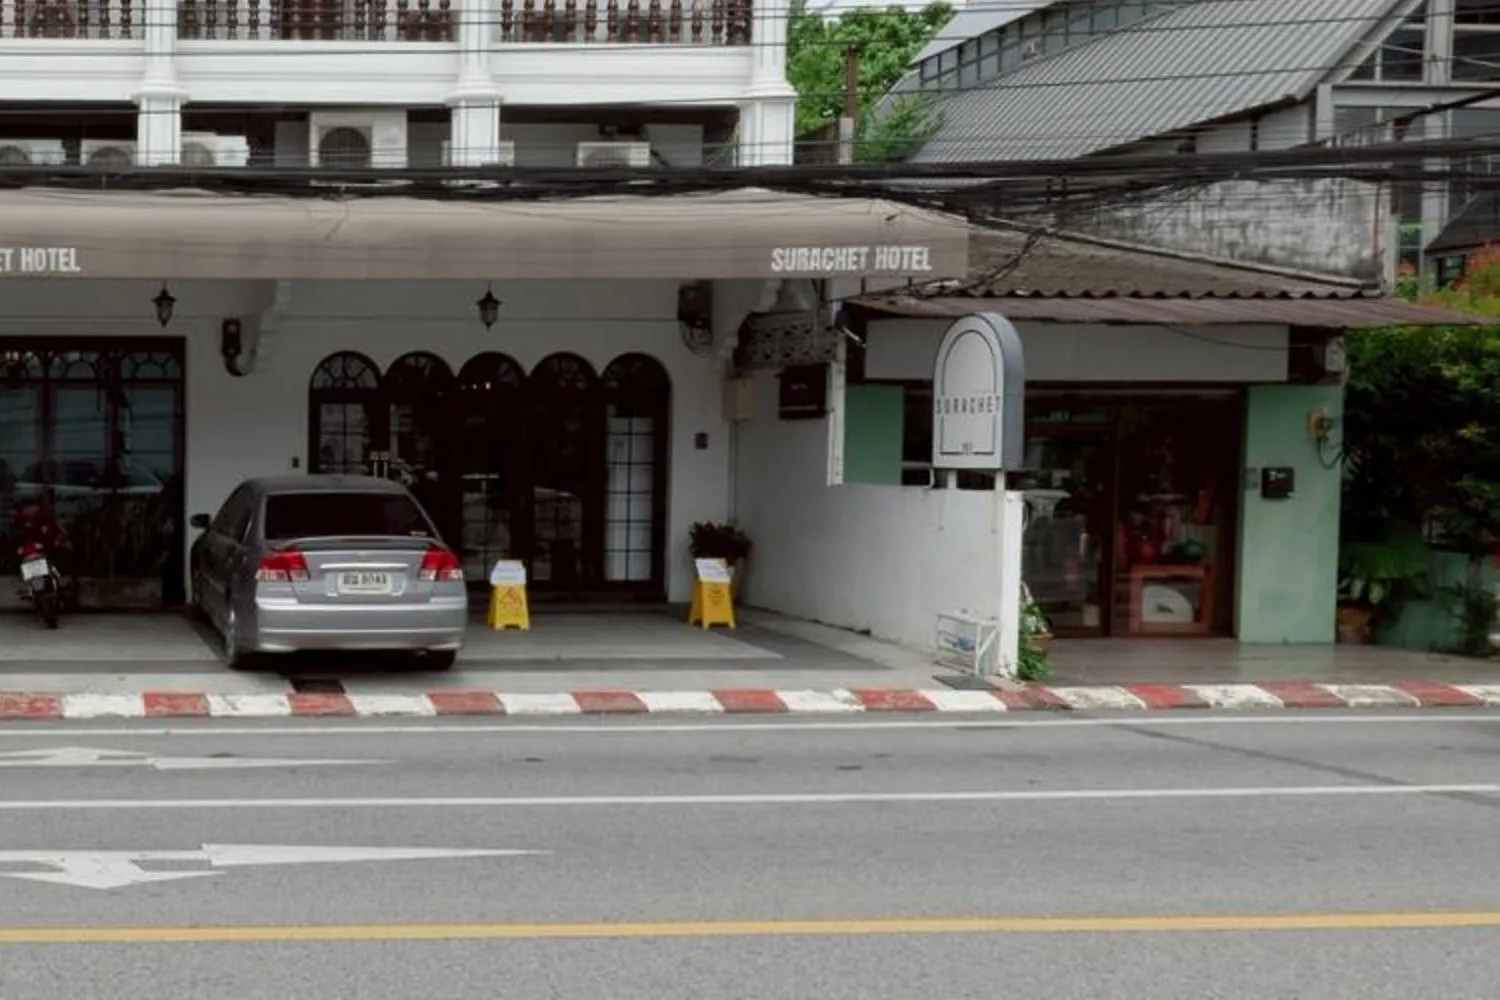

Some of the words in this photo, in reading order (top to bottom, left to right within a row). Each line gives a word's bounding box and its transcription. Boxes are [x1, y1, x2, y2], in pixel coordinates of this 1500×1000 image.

[20, 247, 81, 272] HOTEL
[771, 246, 869, 272] SURACHET
[874, 245, 933, 271] HOTEL
[936, 395, 1001, 415] SURACHET
